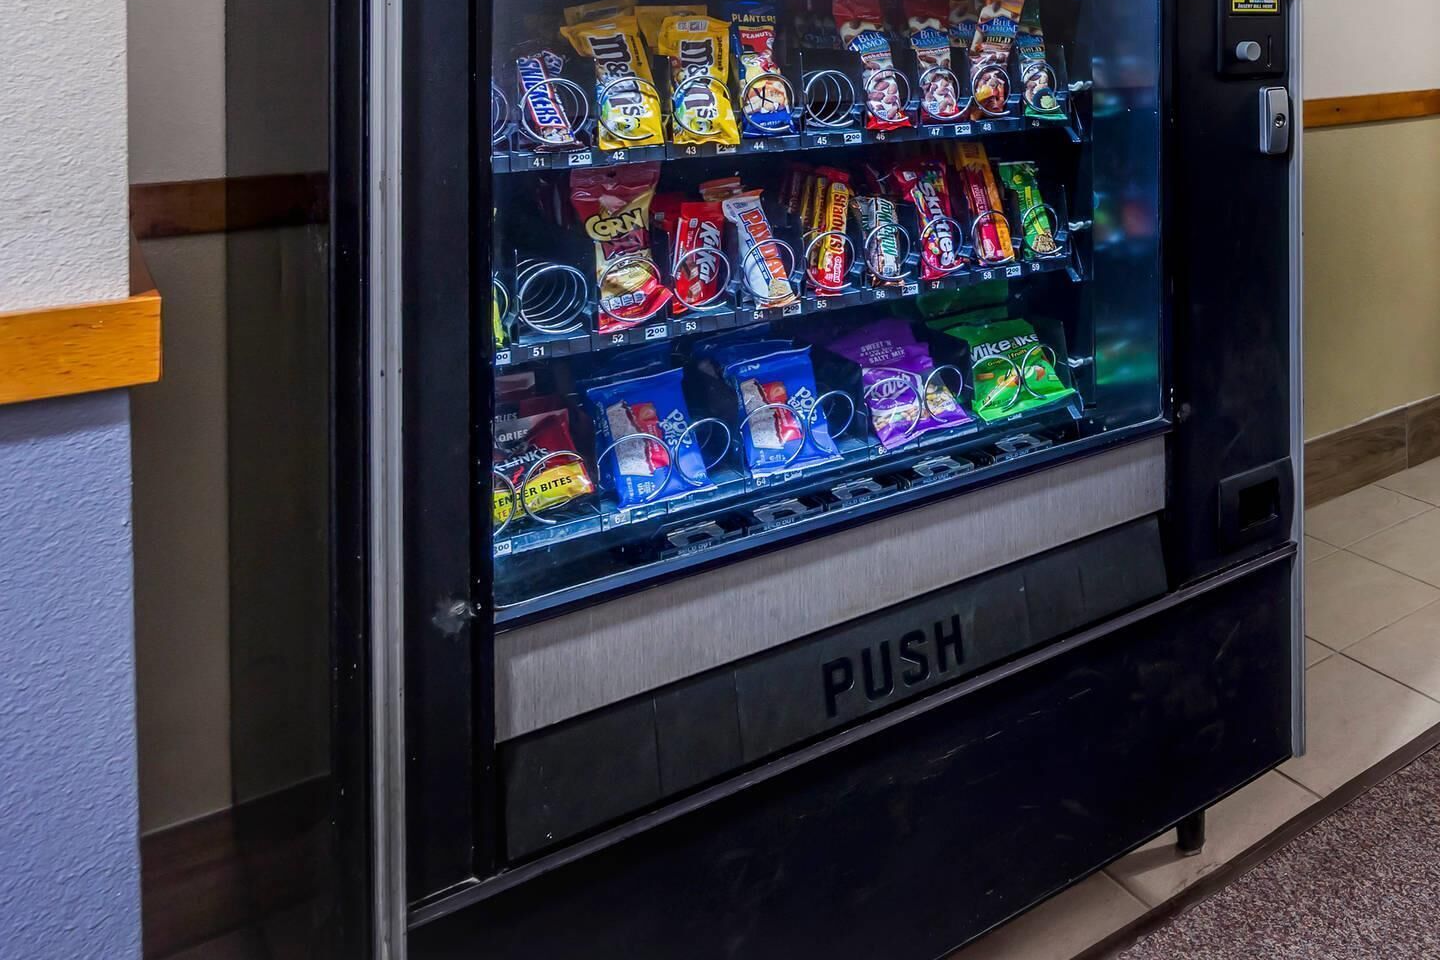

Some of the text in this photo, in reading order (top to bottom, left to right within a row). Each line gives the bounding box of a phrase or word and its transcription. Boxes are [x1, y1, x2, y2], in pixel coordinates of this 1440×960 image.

[993, 17, 1012, 27] BLUE
[858, 31, 881, 43] BLUE
[519, 57, 563, 126] SNICKERS
[931, 128, 940, 136] 47
[982, 123, 992, 131] 48
[817, 136, 828, 146] 45
[875, 133, 886, 141] 46
[685, 146, 697, 155] 43
[753, 141, 765, 151] 44
[612, 152, 625, 161] 42
[533, 157, 545, 168] 41
[879, 200, 894, 224] Way
[585, 208, 646, 242] CORN
[917, 181, 955, 267] Skittles
[1031, 263, 1041, 272] 59
[983, 272, 992, 280] 58
[931, 280, 940, 289] 57
[875, 290, 886, 299] 56
[816, 300, 828, 309] 55
[753, 310, 764, 320] 54
[685, 321, 697, 331] 53
[611, 333, 624, 344] 52
[532, 346, 545, 357] 51
[496, 353, 509, 361] 00
[541, 475, 573, 493] BITES
[756, 477, 767, 487] 64
[614, 514, 626, 524] 62
[821, 613, 964, 719] PUSH
